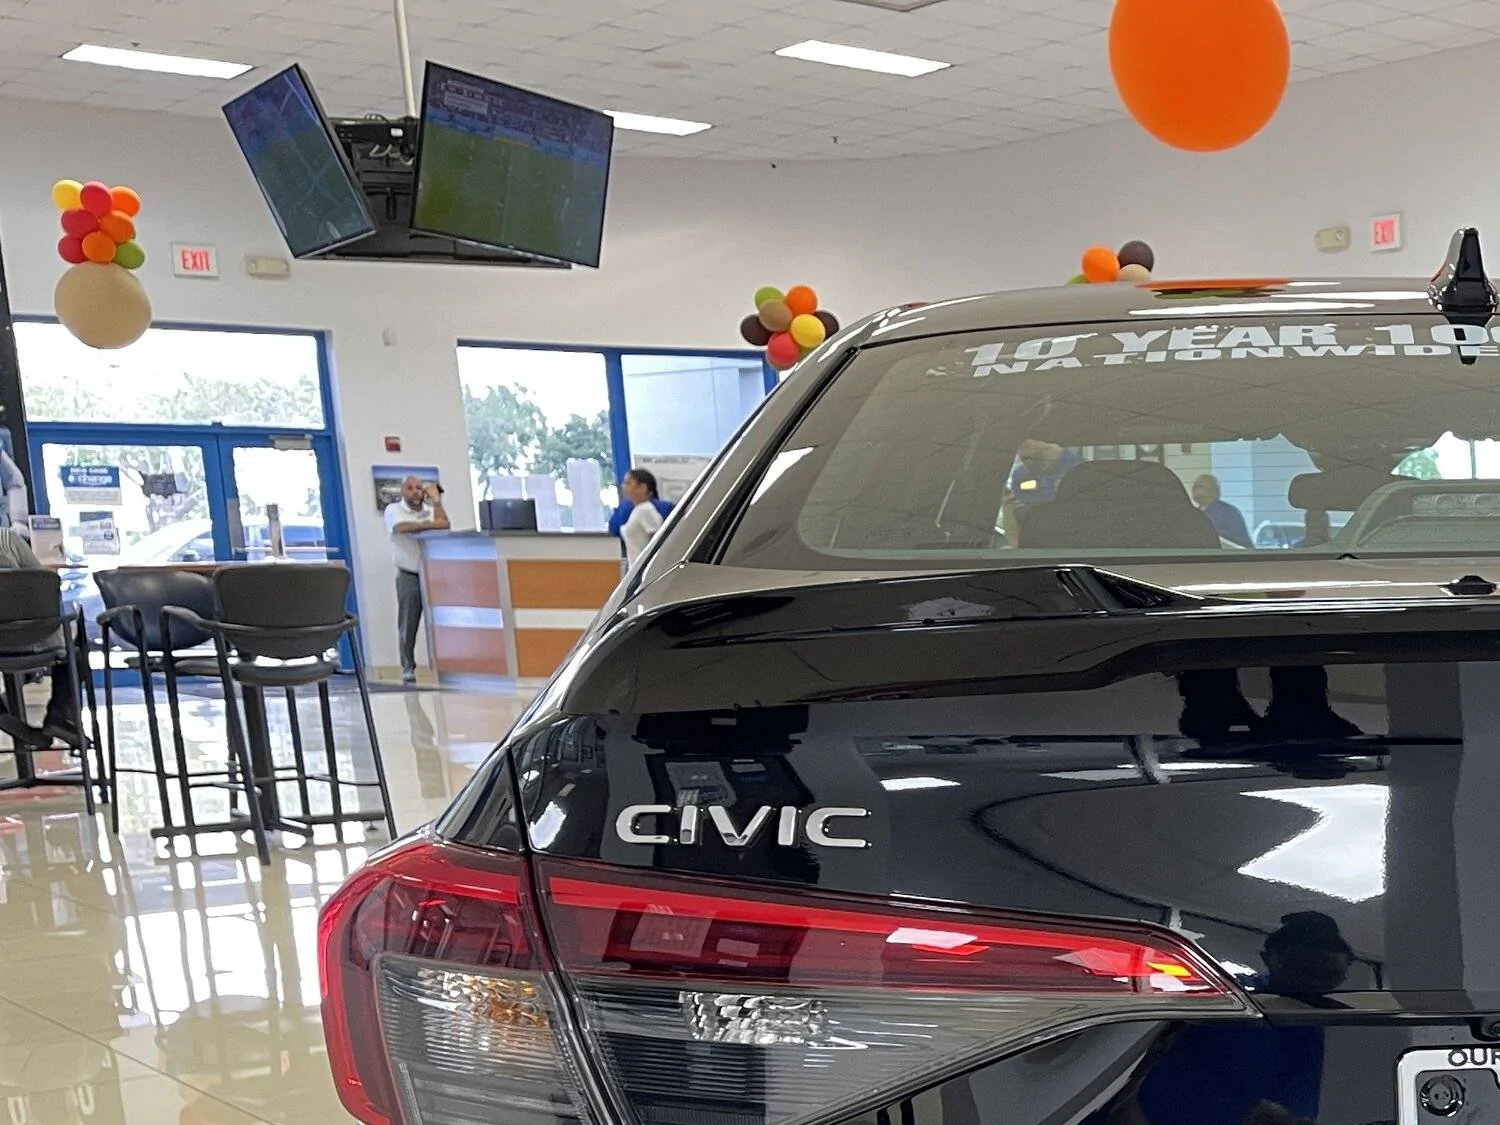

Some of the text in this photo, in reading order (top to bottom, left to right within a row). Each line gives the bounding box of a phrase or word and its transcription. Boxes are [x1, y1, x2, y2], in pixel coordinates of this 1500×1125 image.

[181, 249, 211, 271] EXIT
[966, 334, 1082, 367] 10
[1112, 323, 1338, 353] YEAR
[973, 344, 1500, 378] NATIONWIDE
[615, 804, 868, 848] CIVIC
